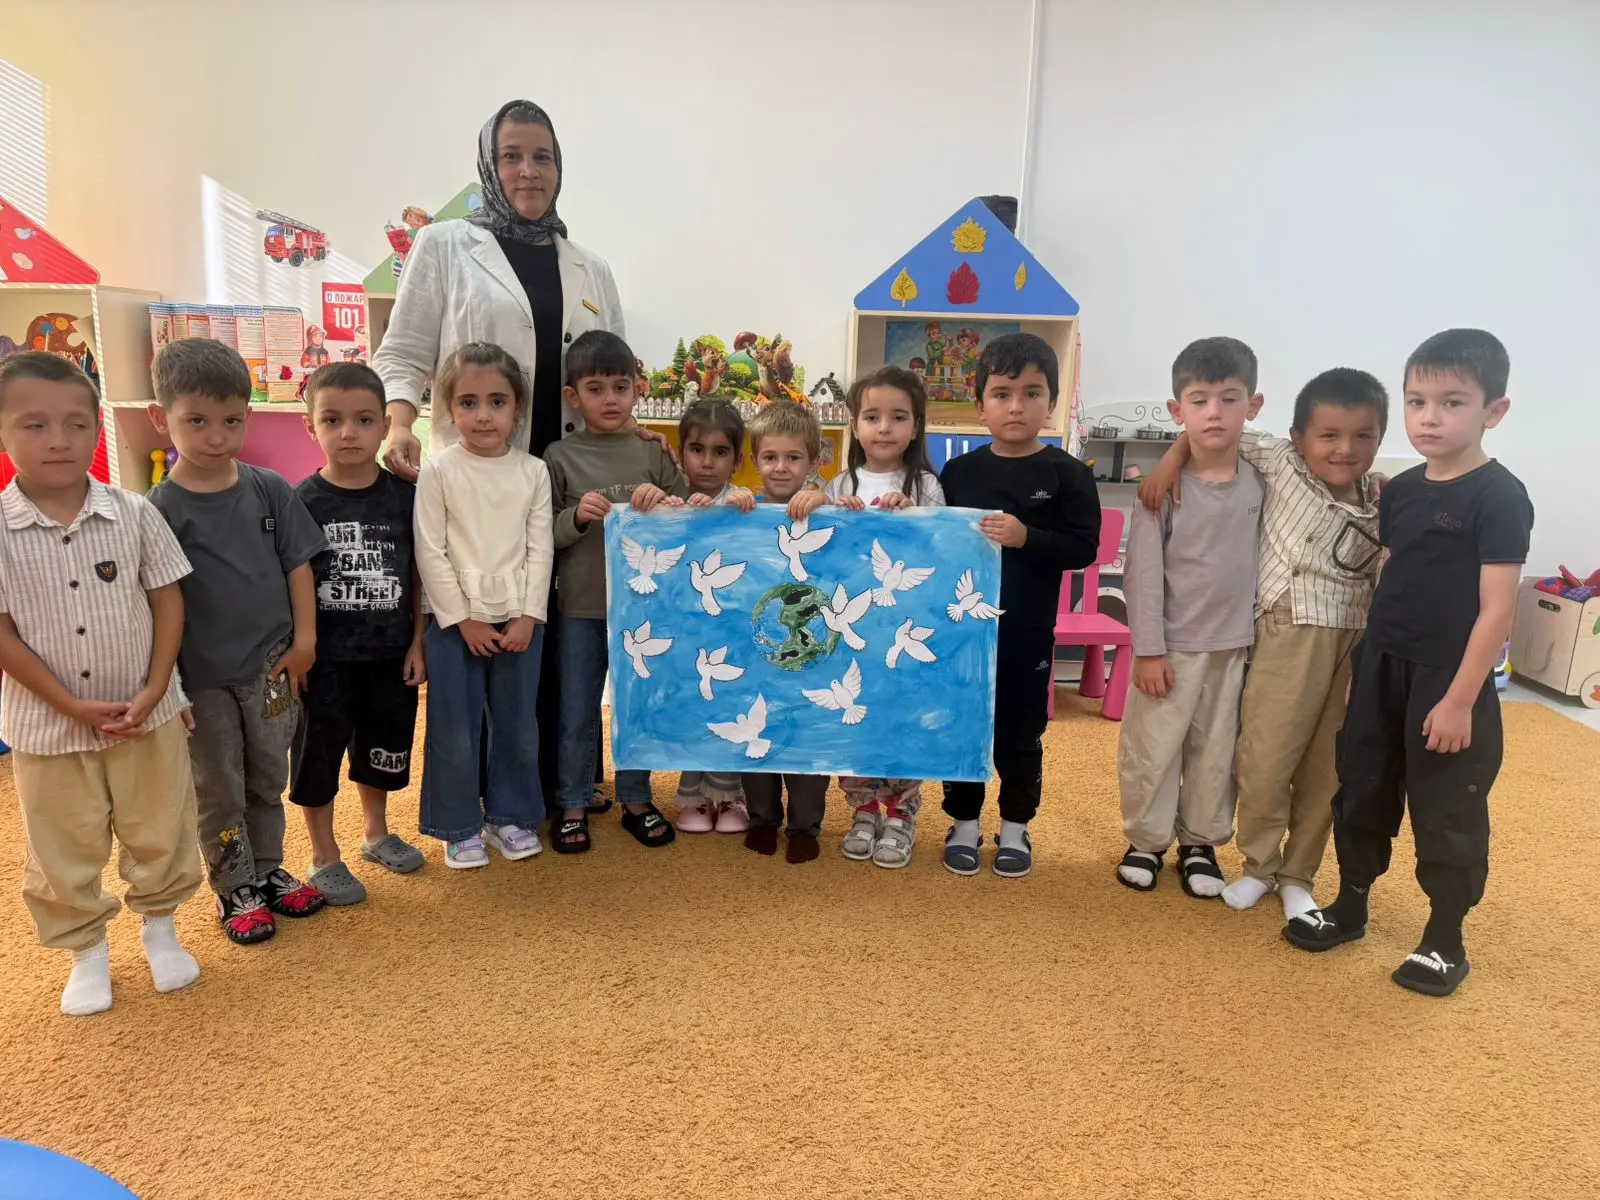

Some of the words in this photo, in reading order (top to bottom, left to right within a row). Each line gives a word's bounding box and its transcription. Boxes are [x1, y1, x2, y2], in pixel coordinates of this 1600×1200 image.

[327, 292, 333, 302] О
[333, 307, 359, 329] 101
[340, 552, 382, 572] BAN
[330, 580, 397, 600] STREET
